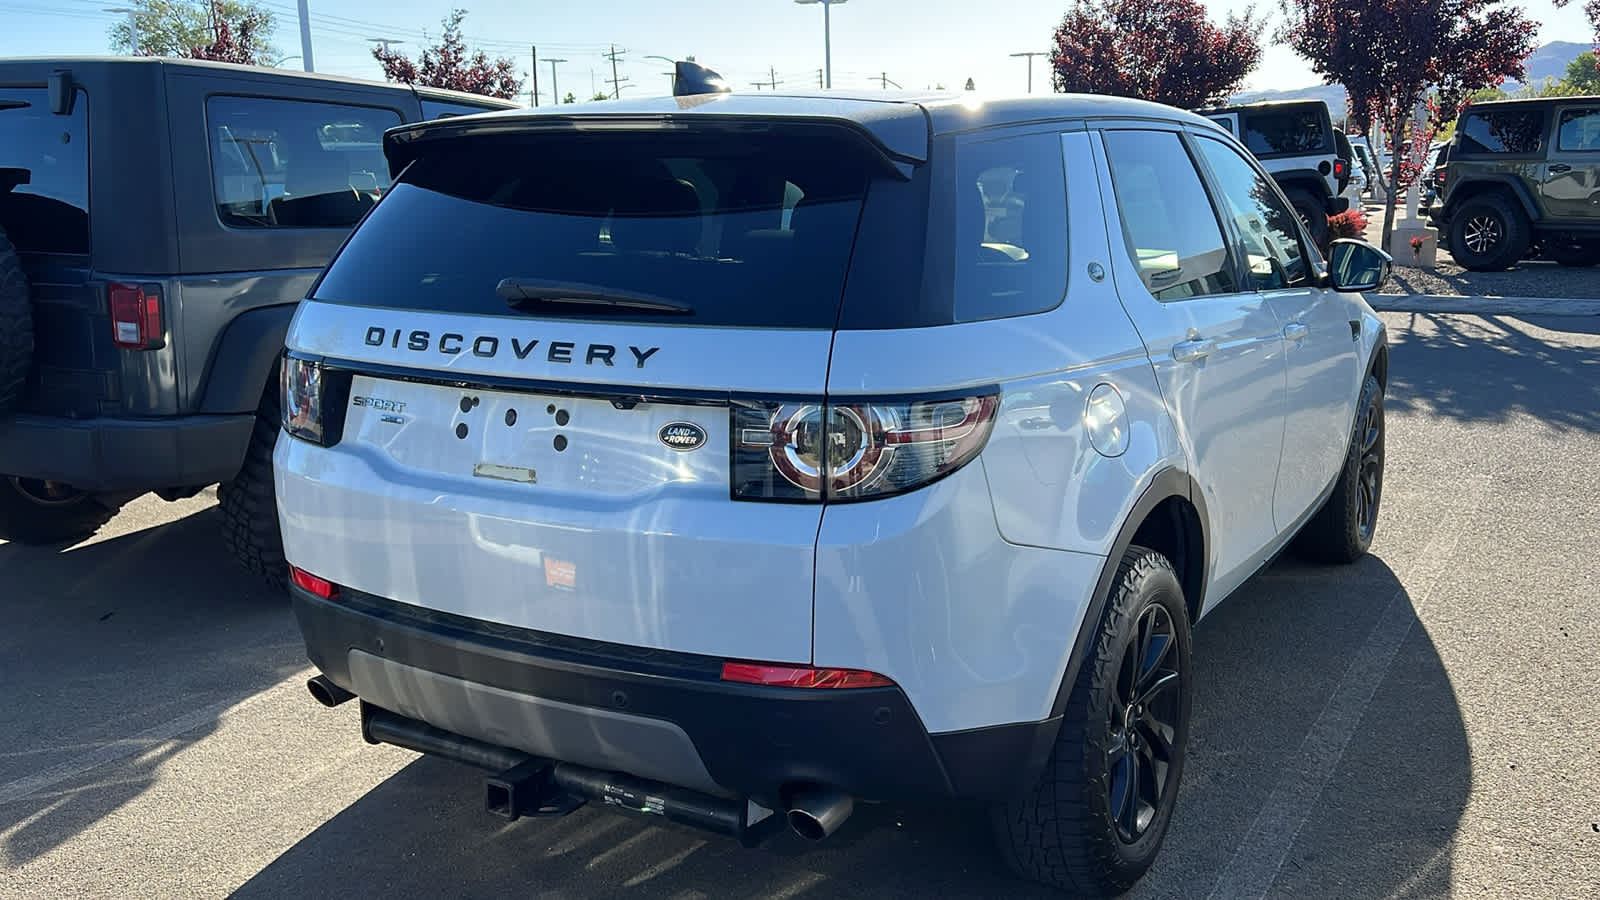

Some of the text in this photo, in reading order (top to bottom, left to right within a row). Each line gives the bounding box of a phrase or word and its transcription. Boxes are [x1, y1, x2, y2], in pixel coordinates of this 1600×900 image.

[365, 326, 660, 368] DISCOVERY
[353, 395, 407, 413] SPORT
[667, 427, 691, 437] LAND
[668, 435, 698, 445] ROVER
